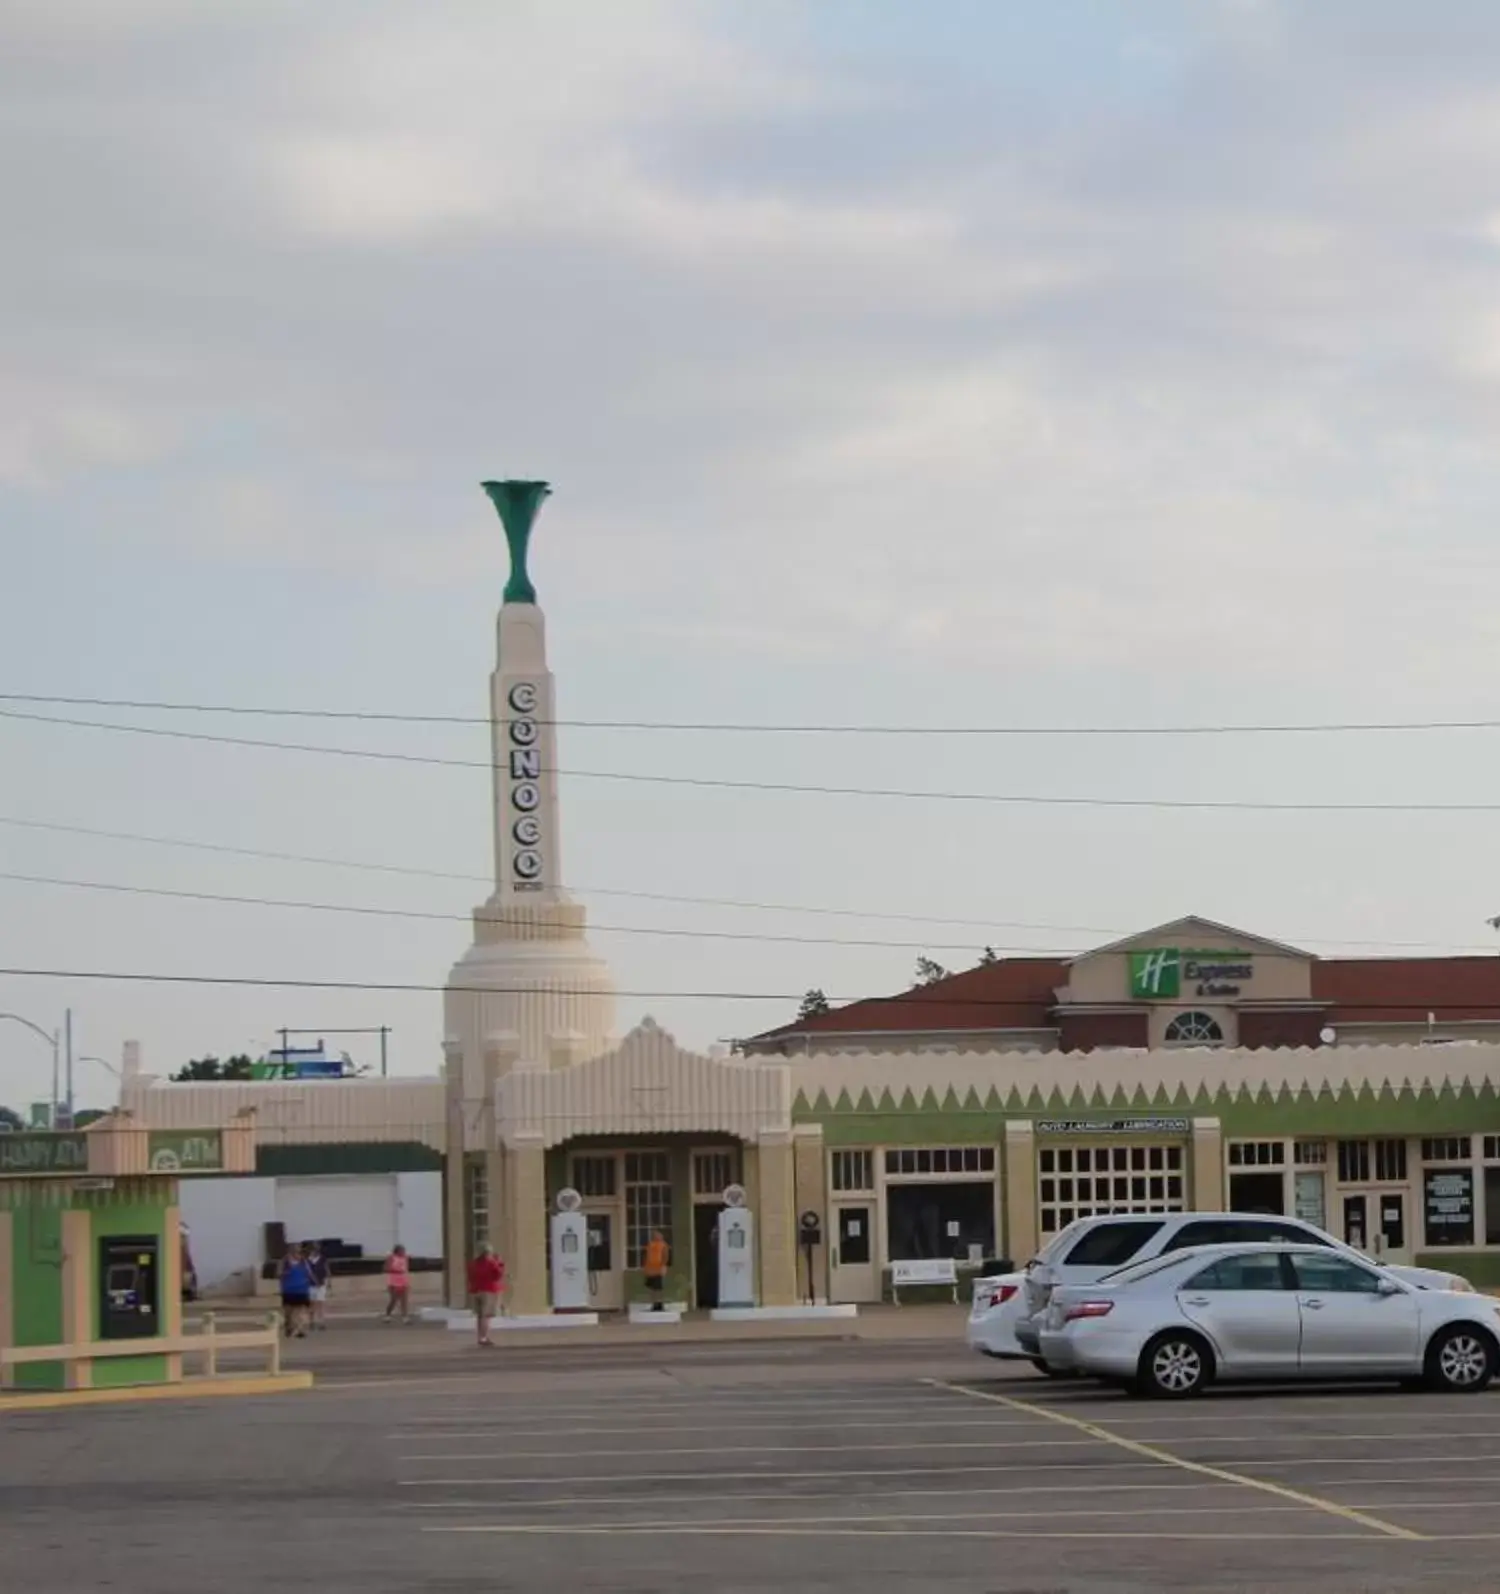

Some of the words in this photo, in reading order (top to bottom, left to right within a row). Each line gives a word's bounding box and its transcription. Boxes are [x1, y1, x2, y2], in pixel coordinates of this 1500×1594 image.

[508, 682, 542, 879] CONOCO
[1184, 961, 1253, 983] Express
[182, 1137, 219, 1162] ATM
